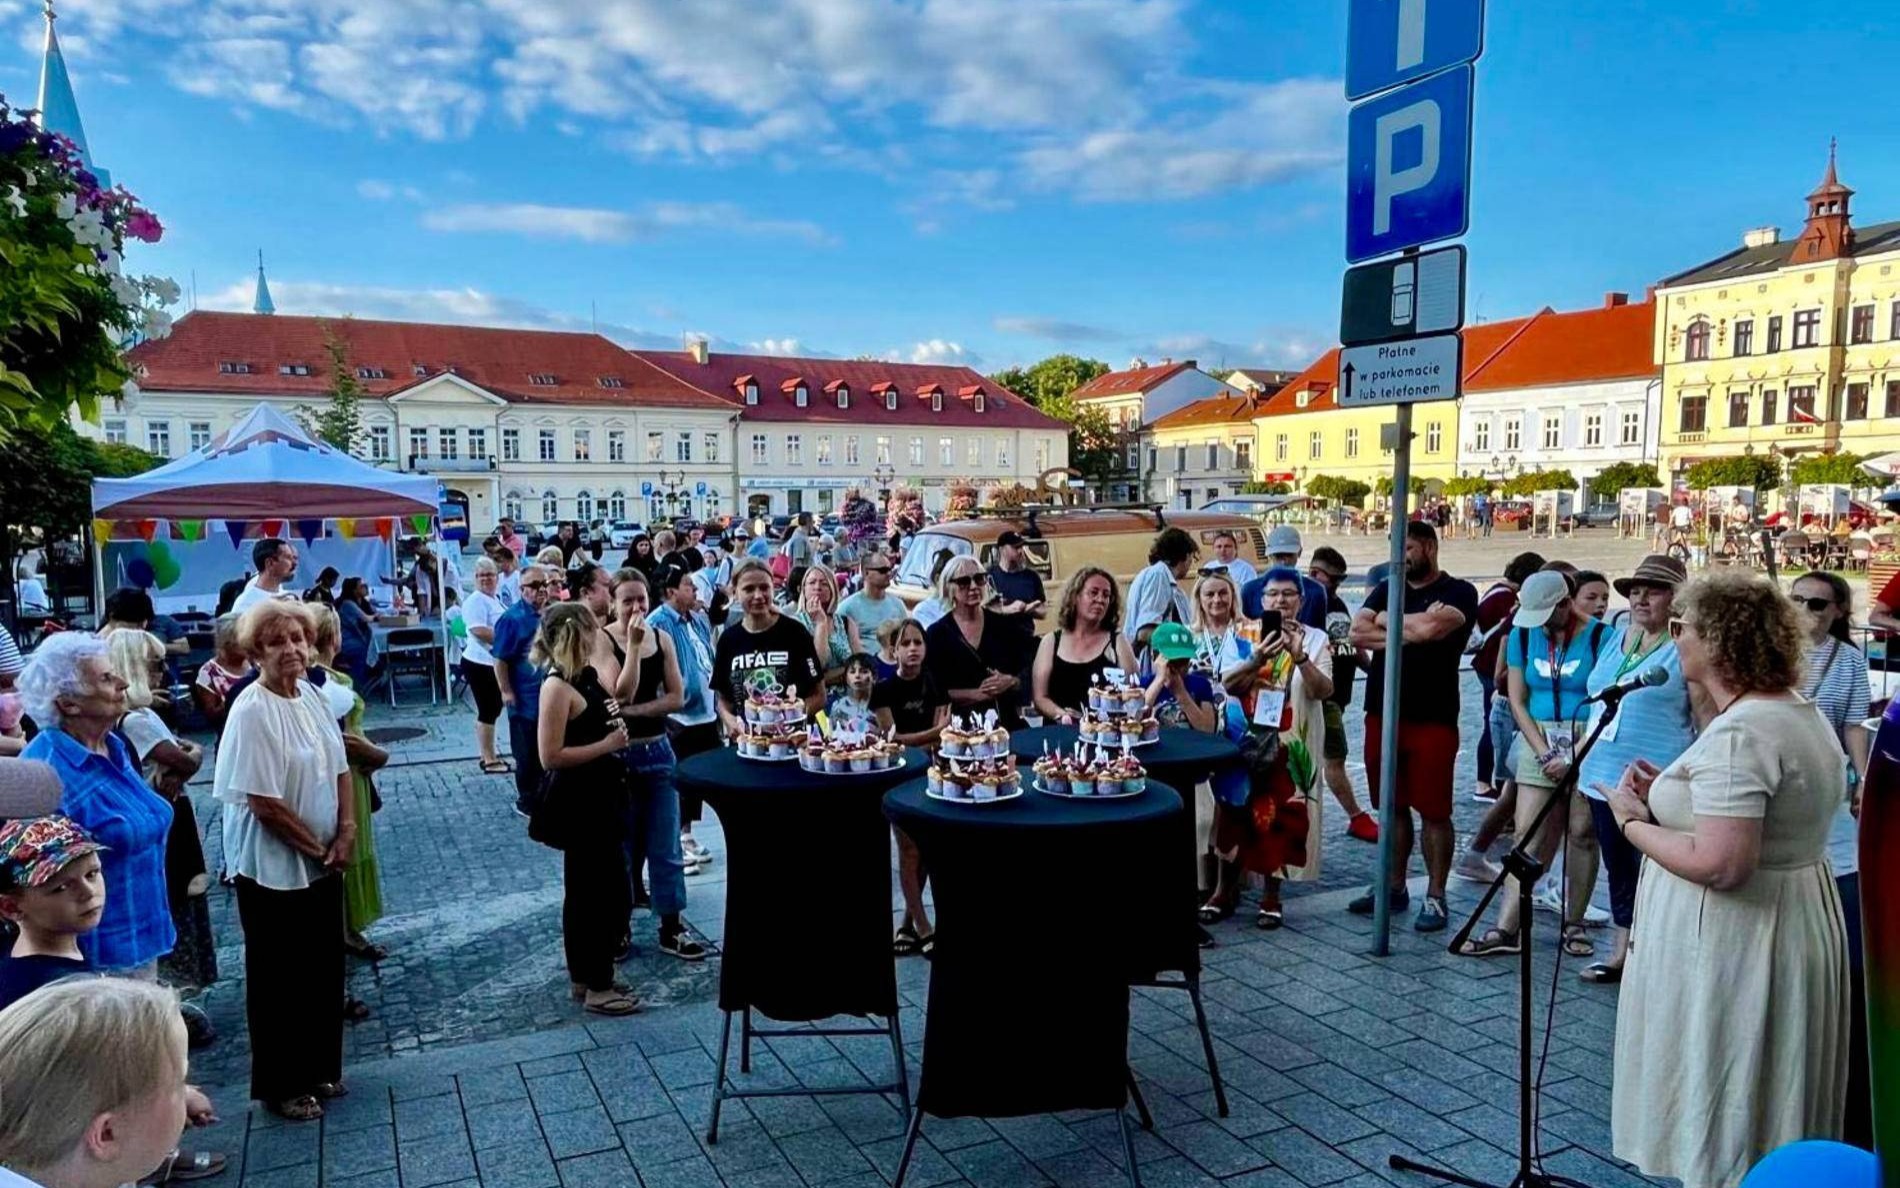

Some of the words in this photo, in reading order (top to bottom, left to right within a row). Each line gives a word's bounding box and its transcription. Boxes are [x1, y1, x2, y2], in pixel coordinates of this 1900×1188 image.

[1373, 99, 1442, 237] P
[1378, 346, 1416, 359] Płatne
[1360, 373, 1368, 381] w
[1372, 362, 1440, 383] parkomacie
[1360, 389, 1376, 400] lub
[1381, 385, 1440, 398] telefonem
